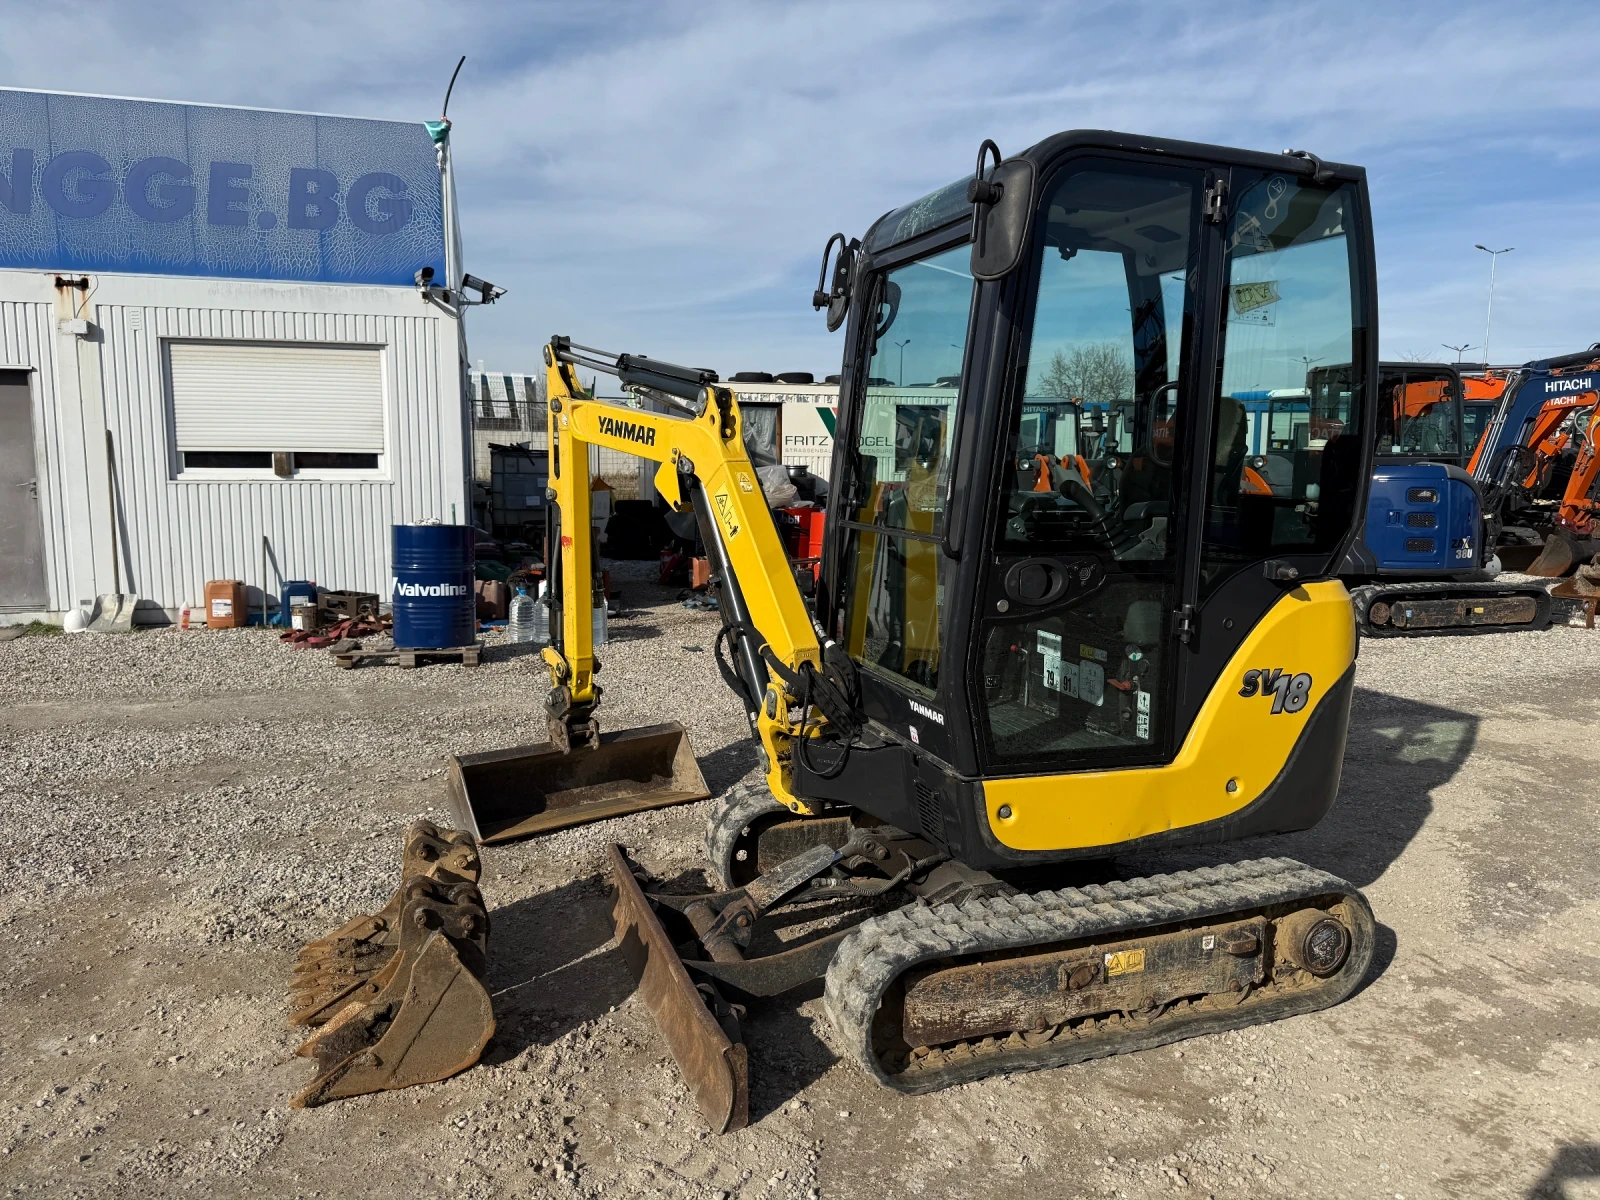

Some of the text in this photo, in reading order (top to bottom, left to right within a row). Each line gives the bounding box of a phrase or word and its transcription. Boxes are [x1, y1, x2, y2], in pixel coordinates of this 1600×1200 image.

[1545, 378, 1592, 393] HITACHI
[598, 415, 656, 447] YANMAR
[785, 435, 828, 446] FRITZ
[1451, 535, 1475, 549] ZAXS
[1456, 548, 1473, 559] 38U
[397, 582, 467, 597] Valvoline
[1046, 669, 1055, 687] 79
[1063, 675, 1072, 693] 91
[1238, 667, 1313, 715] SV18
[908, 698, 945, 726] YANMAR
